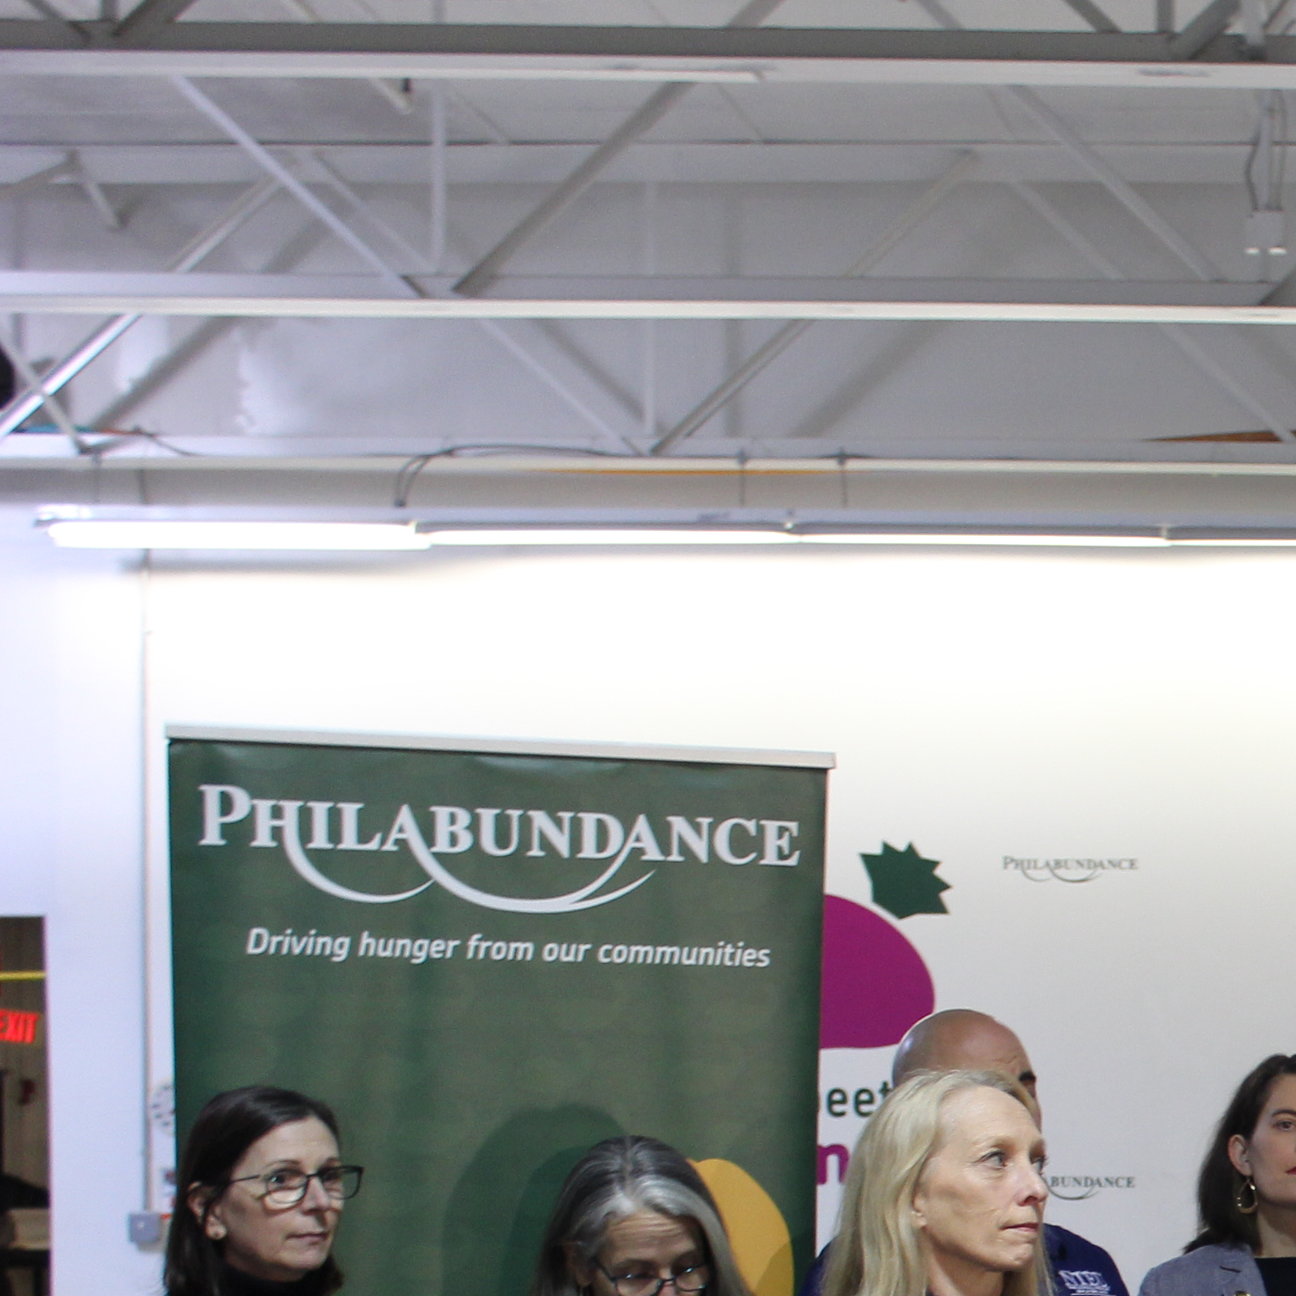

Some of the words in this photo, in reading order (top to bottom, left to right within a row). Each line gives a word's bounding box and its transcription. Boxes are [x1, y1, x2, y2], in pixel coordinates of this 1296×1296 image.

[199, 784, 801, 913] PHILABUNDANCE
[1002, 855, 1138, 883] PHILABUNDANCE
[247, 926, 351, 962] Driving
[357, 930, 461, 964] hunger
[466, 933, 534, 961] from
[541, 942, 592, 963] our
[597, 941, 771, 968] communities
